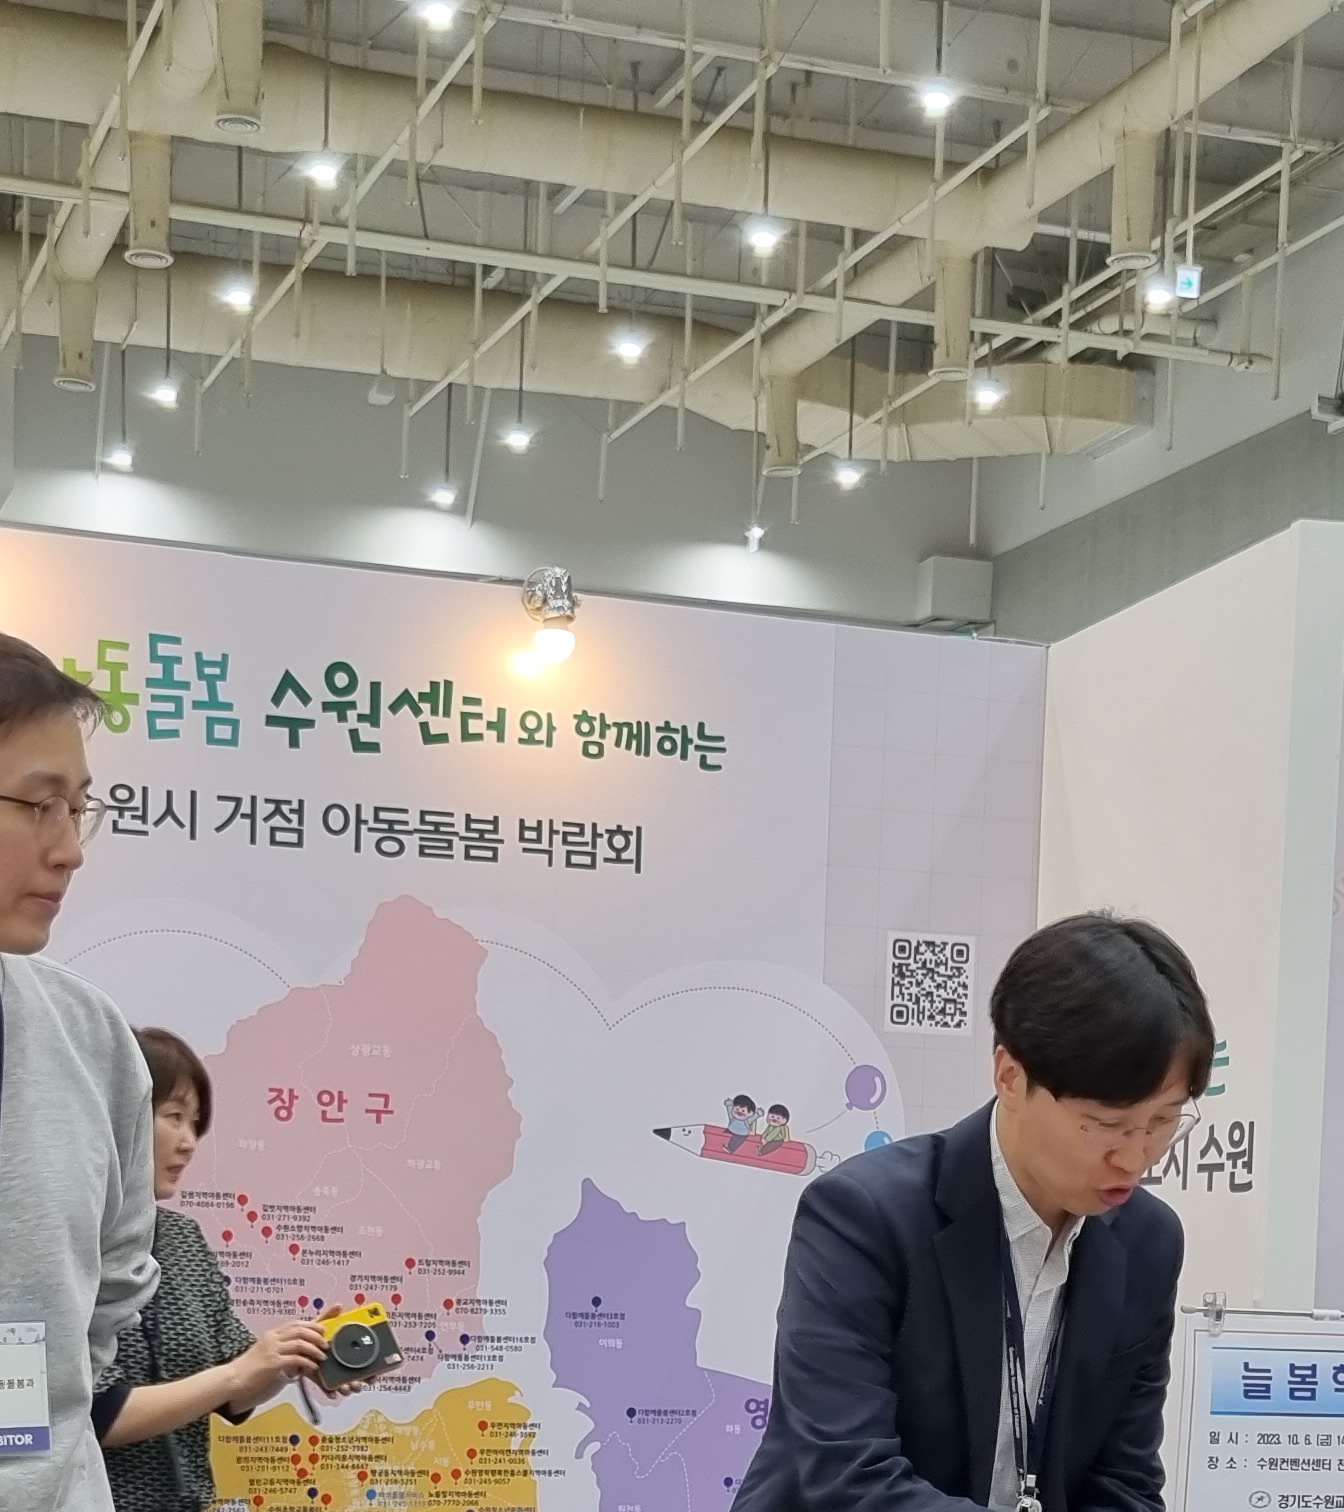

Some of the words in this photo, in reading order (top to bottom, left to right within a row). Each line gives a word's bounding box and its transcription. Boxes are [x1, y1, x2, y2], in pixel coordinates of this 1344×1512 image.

[573, 709, 727, 772] 함께하는
[101, 783, 199, 842] 원시
[214, 795, 305, 849] 거점
[322, 803, 505, 863] 아동돌봄
[517, 816, 644, 875] 박람회
[267, 1087, 395, 1125] 장안구
[1196, 1121, 1255, 1193] 수원
[1256, 1457, 1332, 1472] 수원컨벤션센터
